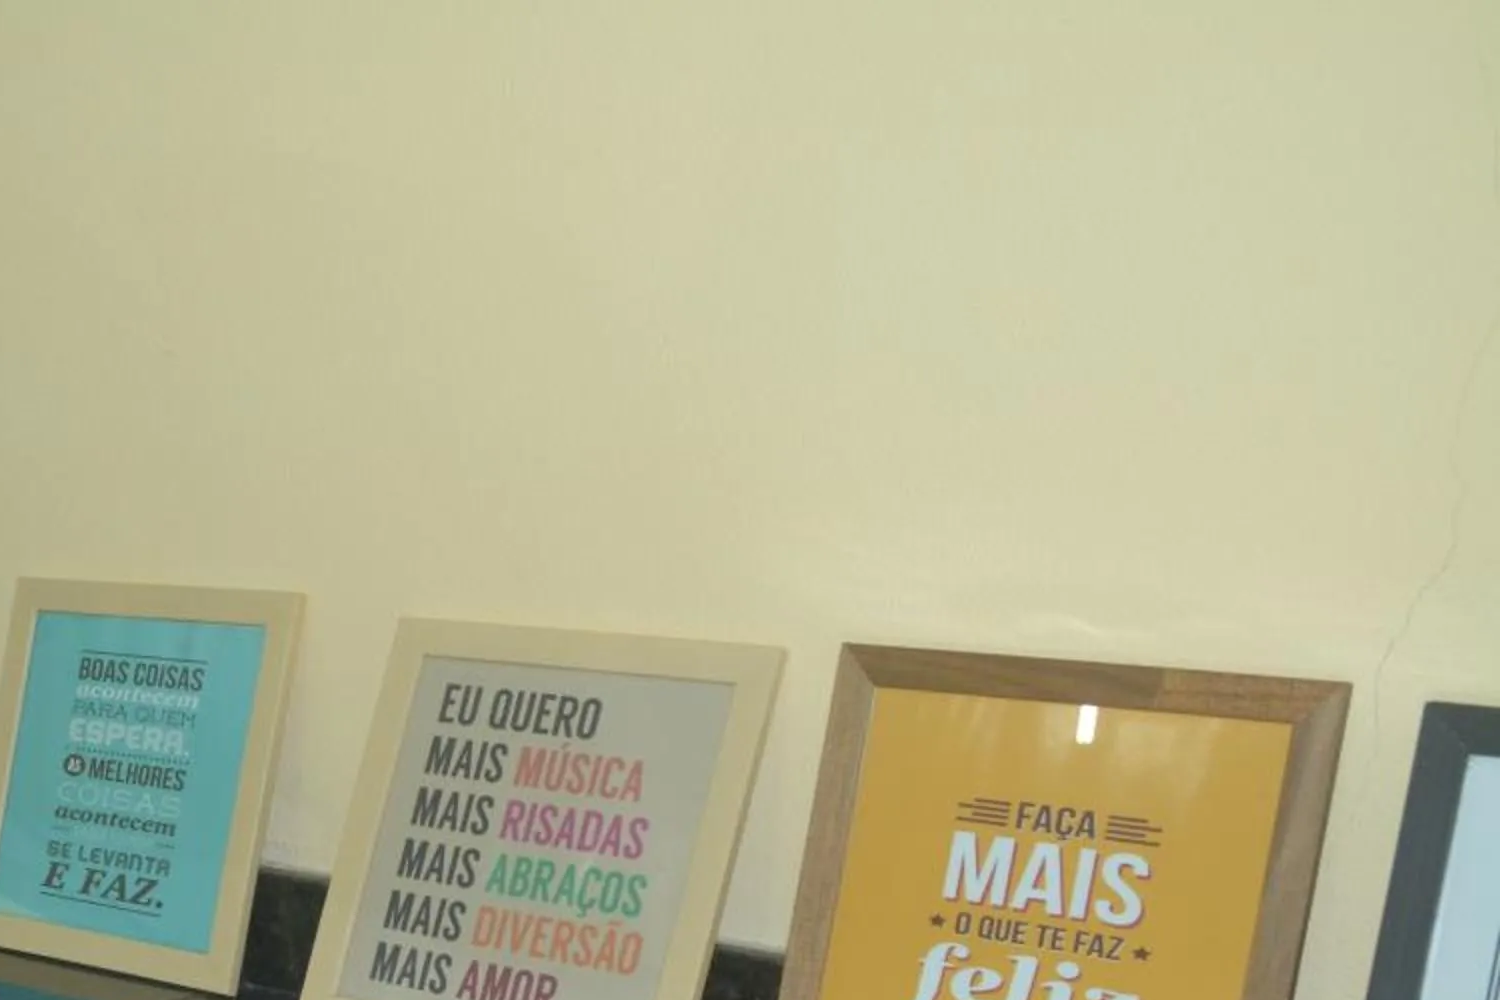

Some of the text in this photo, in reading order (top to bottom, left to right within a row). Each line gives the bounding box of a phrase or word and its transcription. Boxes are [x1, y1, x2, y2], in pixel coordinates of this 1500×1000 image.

[75, 682, 200, 710] acontecem
[78, 657, 205, 692] BOAS COISAS
[71, 699, 197, 729] PARA QUEM
[438, 682, 603, 740] EU QUERO
[68, 718, 190, 757] ESPERA.
[88, 757, 187, 792] MELHORES
[424, 735, 644, 803] MAIS MÚSICA
[57, 780, 181, 818] COISAS
[1015, 800, 1096, 840] FAÇA
[55, 805, 176, 837] acontecem
[410, 787, 650, 860] MAIS RISADAS
[47, 840, 171, 877] SE LEVANTA
[397, 838, 648, 919] MAIS ABRAÇOS
[941, 830, 1152, 930] MAIS
[41, 861, 163, 908] E FAZ.
[383, 890, 644, 976] MAIS DIVERSÃO
[954, 911, 1125, 961] O QUE TE FAZ
[369, 942, 453, 995] MAIS
